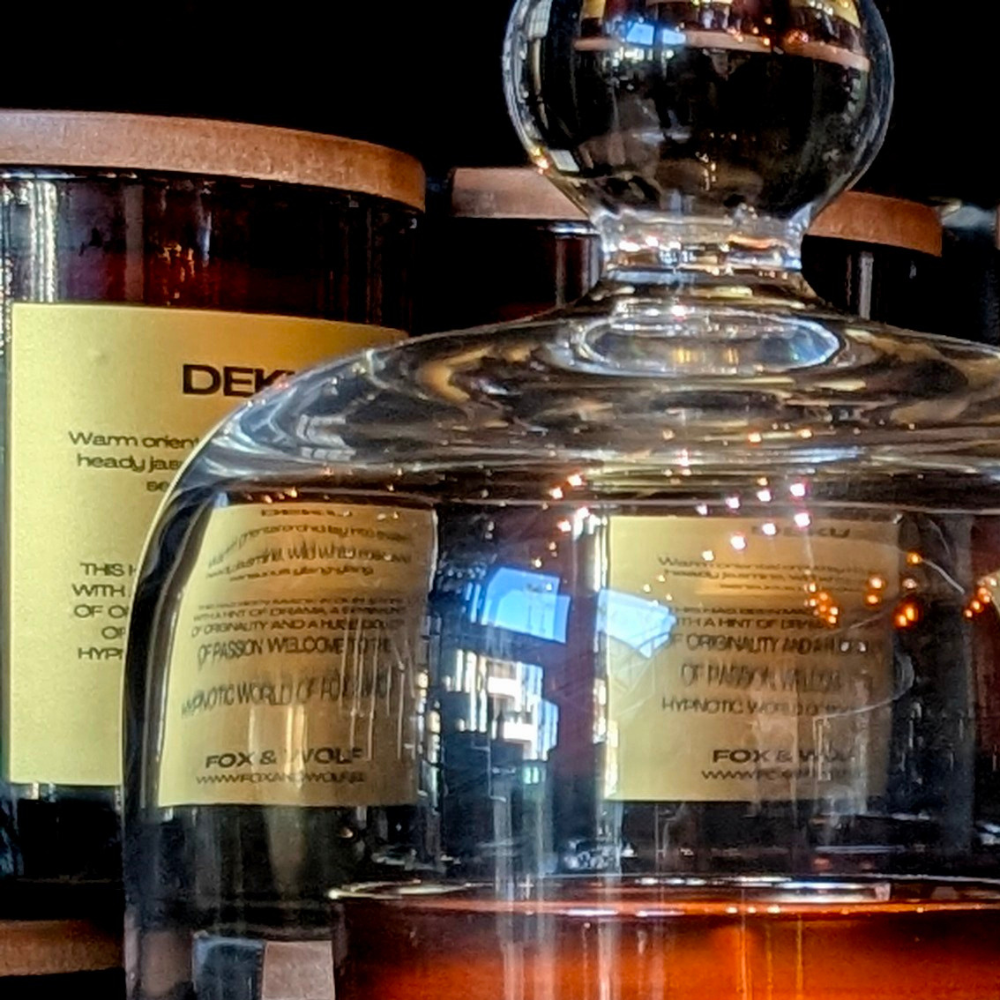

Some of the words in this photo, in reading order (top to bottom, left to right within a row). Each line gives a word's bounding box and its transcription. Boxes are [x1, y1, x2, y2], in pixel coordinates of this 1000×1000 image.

[68, 431, 139, 447] Warm
[77, 453, 145, 473] heady
[80, 563, 125, 577] THIS
[72, 583, 126, 597] WITH
[74, 604, 104, 618] OF
[661, 695, 743, 714] HYPNOTIC
[205, 752, 253, 769] FOX
[259, 750, 277, 765] &
[712, 749, 769, 763] FOX
